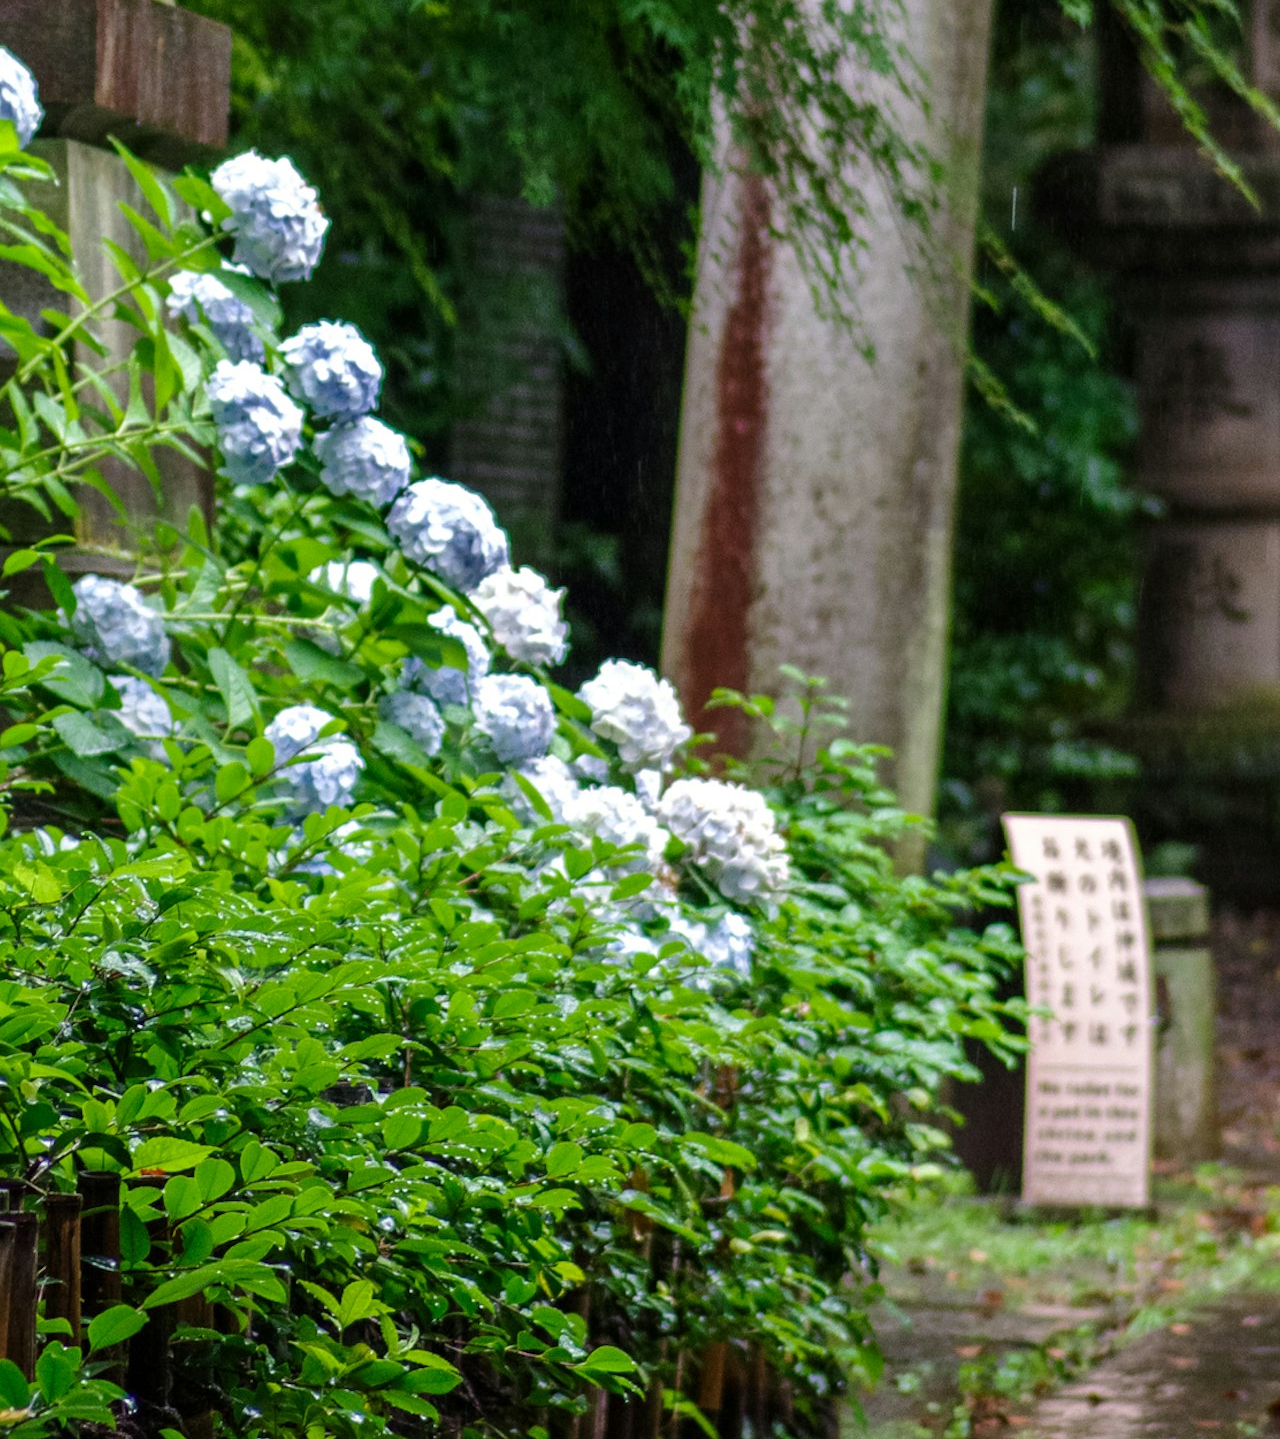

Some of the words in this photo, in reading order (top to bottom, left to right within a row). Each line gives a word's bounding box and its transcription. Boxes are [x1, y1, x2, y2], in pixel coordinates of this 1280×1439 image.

[1074, 836, 1108, 1045] 犬のトイレは
[1038, 1081, 1060, 1097] No
[1067, 1081, 1109, 1098] toilet
[1115, 1082, 1138, 1098] for
[1053, 1104, 1081, 1122] pet
[1085, 1104, 1101, 1120] in
[1106, 1104, 1139, 1121] this
[1038, 1126, 1095, 1141] shrine
[1104, 1127, 1137, 1143] and
[1034, 1147, 1062, 1162] the
